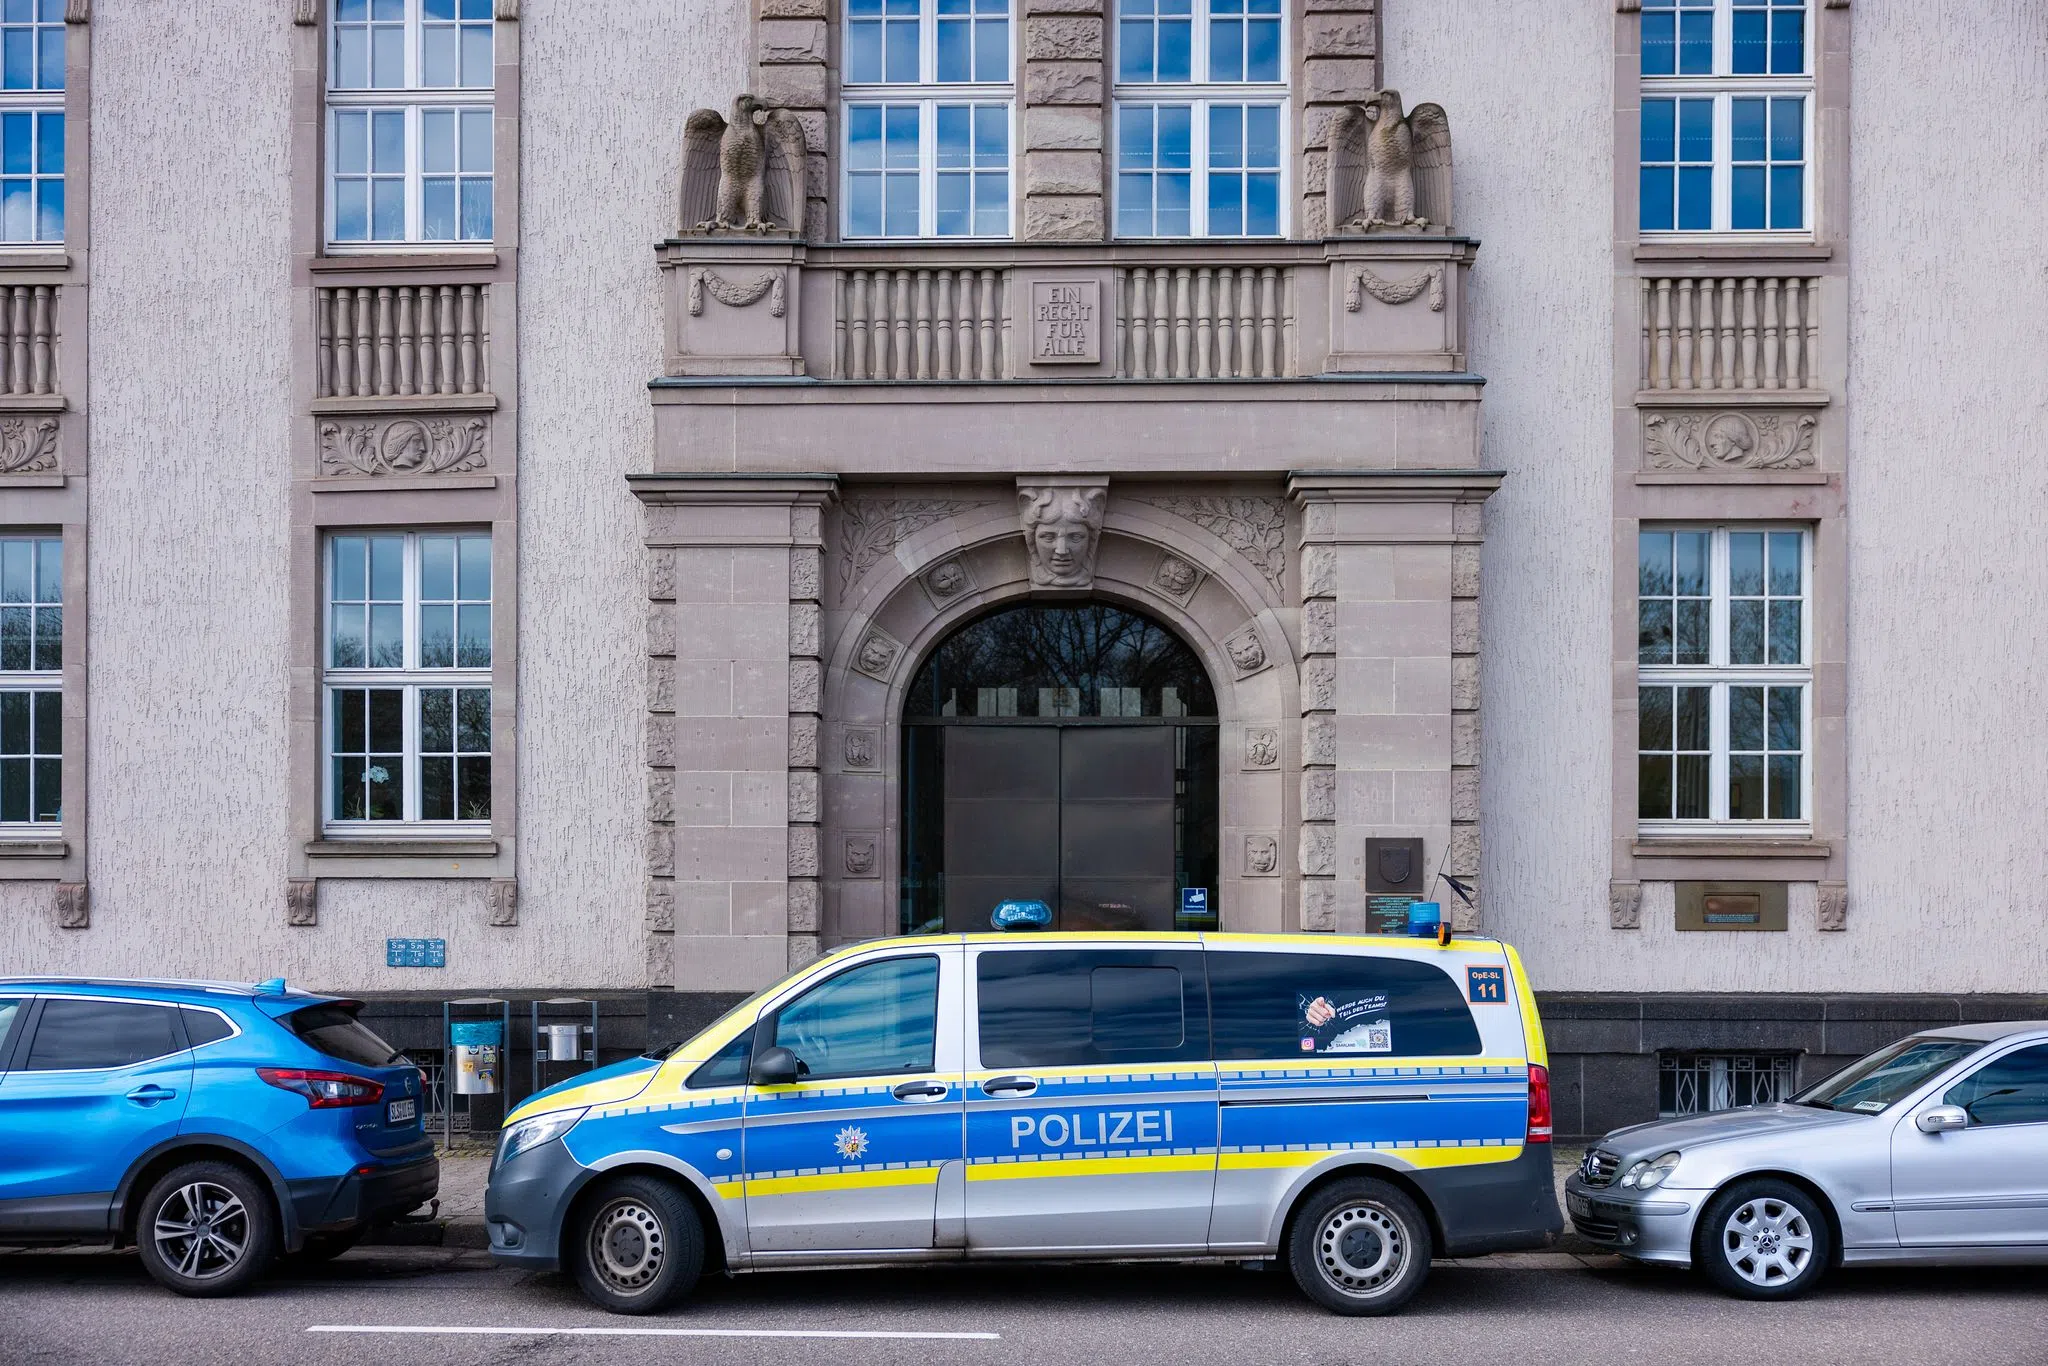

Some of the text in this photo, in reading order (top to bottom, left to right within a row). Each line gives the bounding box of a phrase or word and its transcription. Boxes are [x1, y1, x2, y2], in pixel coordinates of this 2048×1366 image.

[1048, 287, 1081, 304] EIN
[1037, 304, 1092, 321] RECHT
[1040, 339, 1085, 356] ALLE
[391, 941, 397, 949] S
[1472, 971, 1500, 980] OpE-SL
[1478, 983, 1497, 998] 11
[1336, 1001, 1356, 1013] WERDE
[1357, 997, 1374, 1005] AUCH
[1339, 1009, 1352, 1018] TEIL
[1011, 1109, 1173, 1148] POLIZEI
